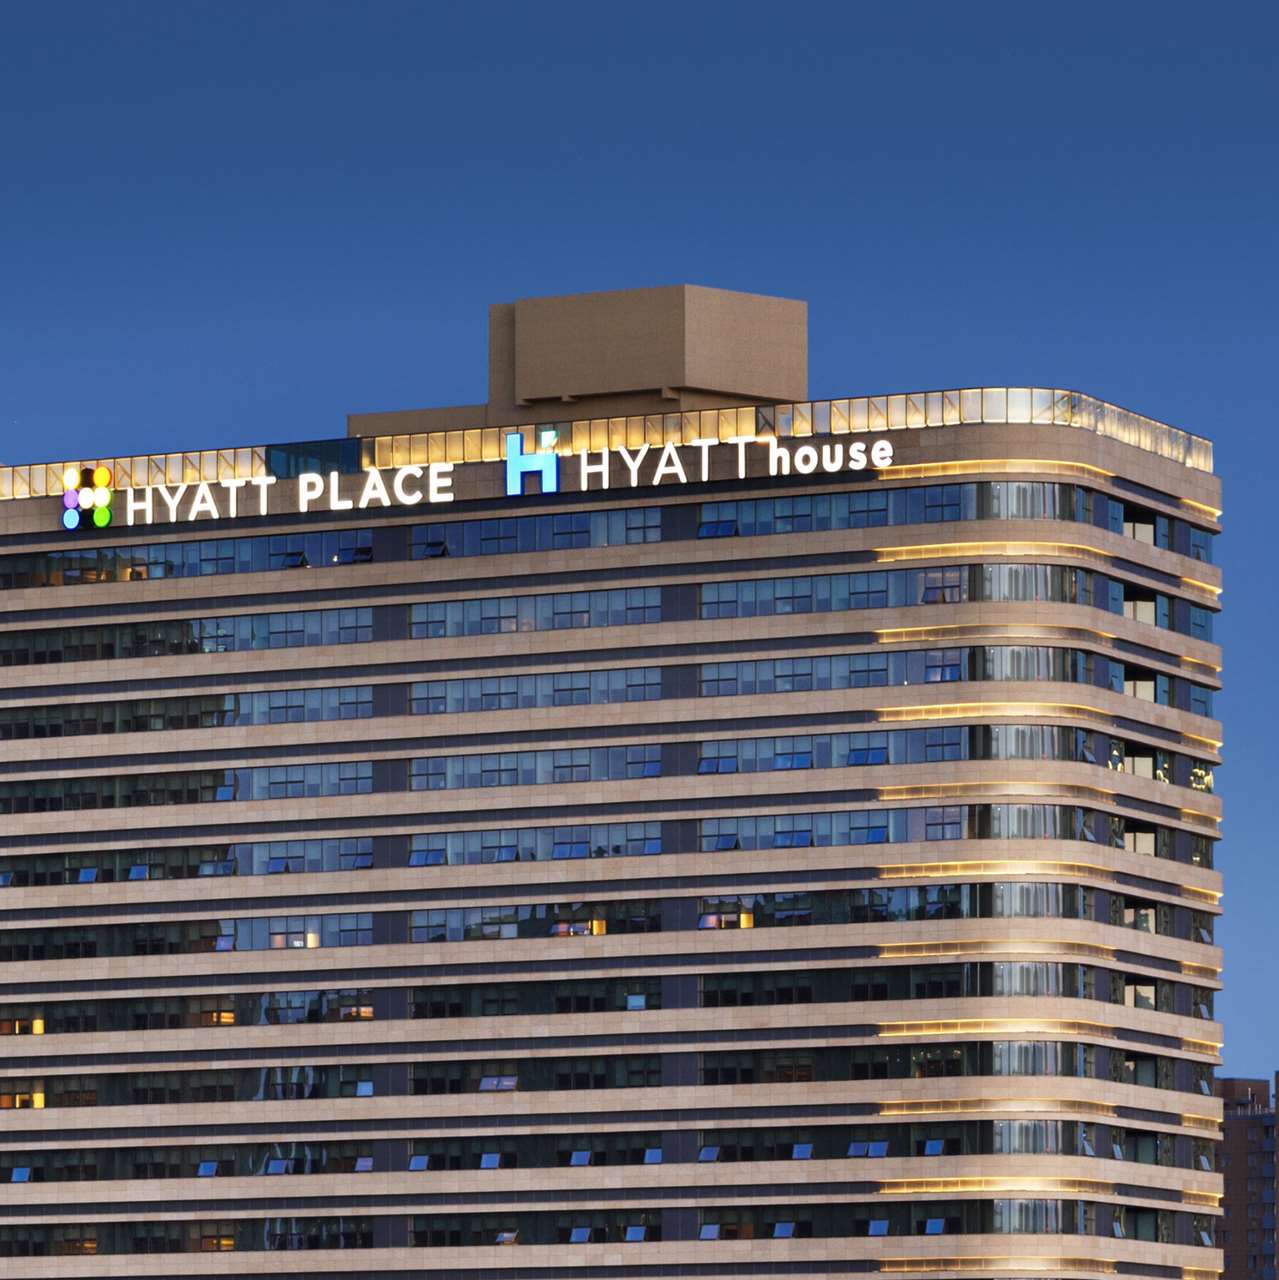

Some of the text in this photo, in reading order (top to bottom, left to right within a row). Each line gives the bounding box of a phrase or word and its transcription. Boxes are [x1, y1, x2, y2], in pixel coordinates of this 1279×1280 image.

[580, 436, 894, 492] HYATT house
[126, 463, 455, 526] HYATT PLACE
